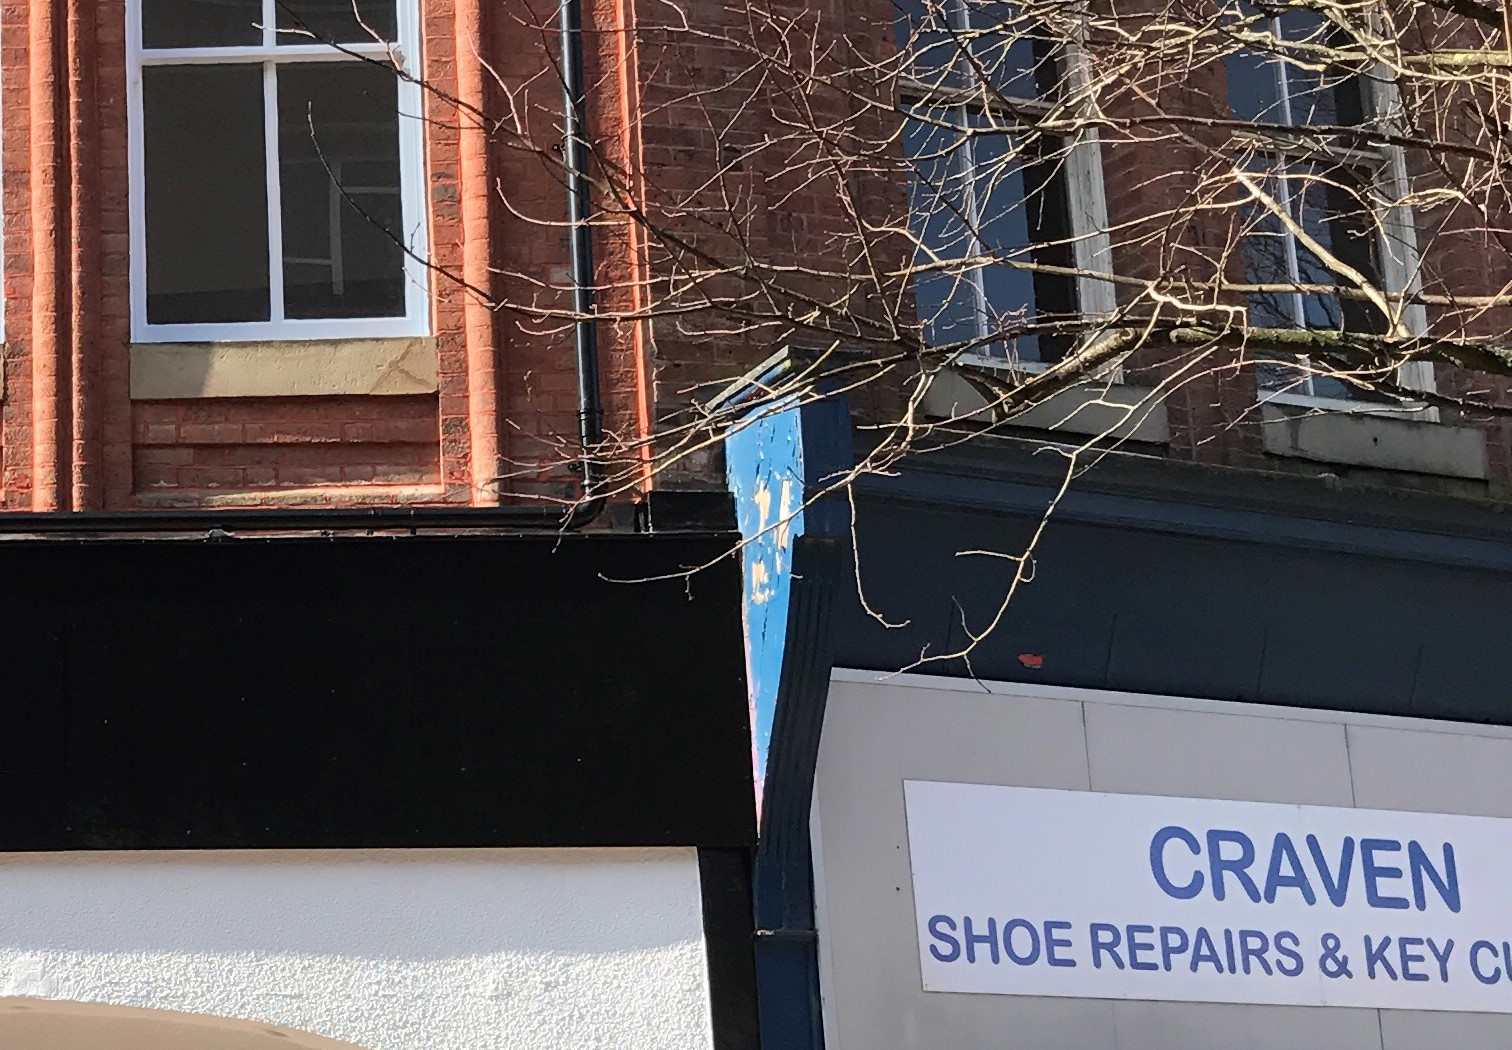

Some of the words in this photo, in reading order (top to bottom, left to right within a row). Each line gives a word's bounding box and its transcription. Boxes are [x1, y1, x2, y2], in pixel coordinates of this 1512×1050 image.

[1149, 825, 1462, 913] CRAVEN
[927, 914, 1076, 968] SHOE
[1089, 921, 1304, 978] REPAIRS
[1319, 933, 1351, 979] &
[1363, 935, 1453, 982] KEY
